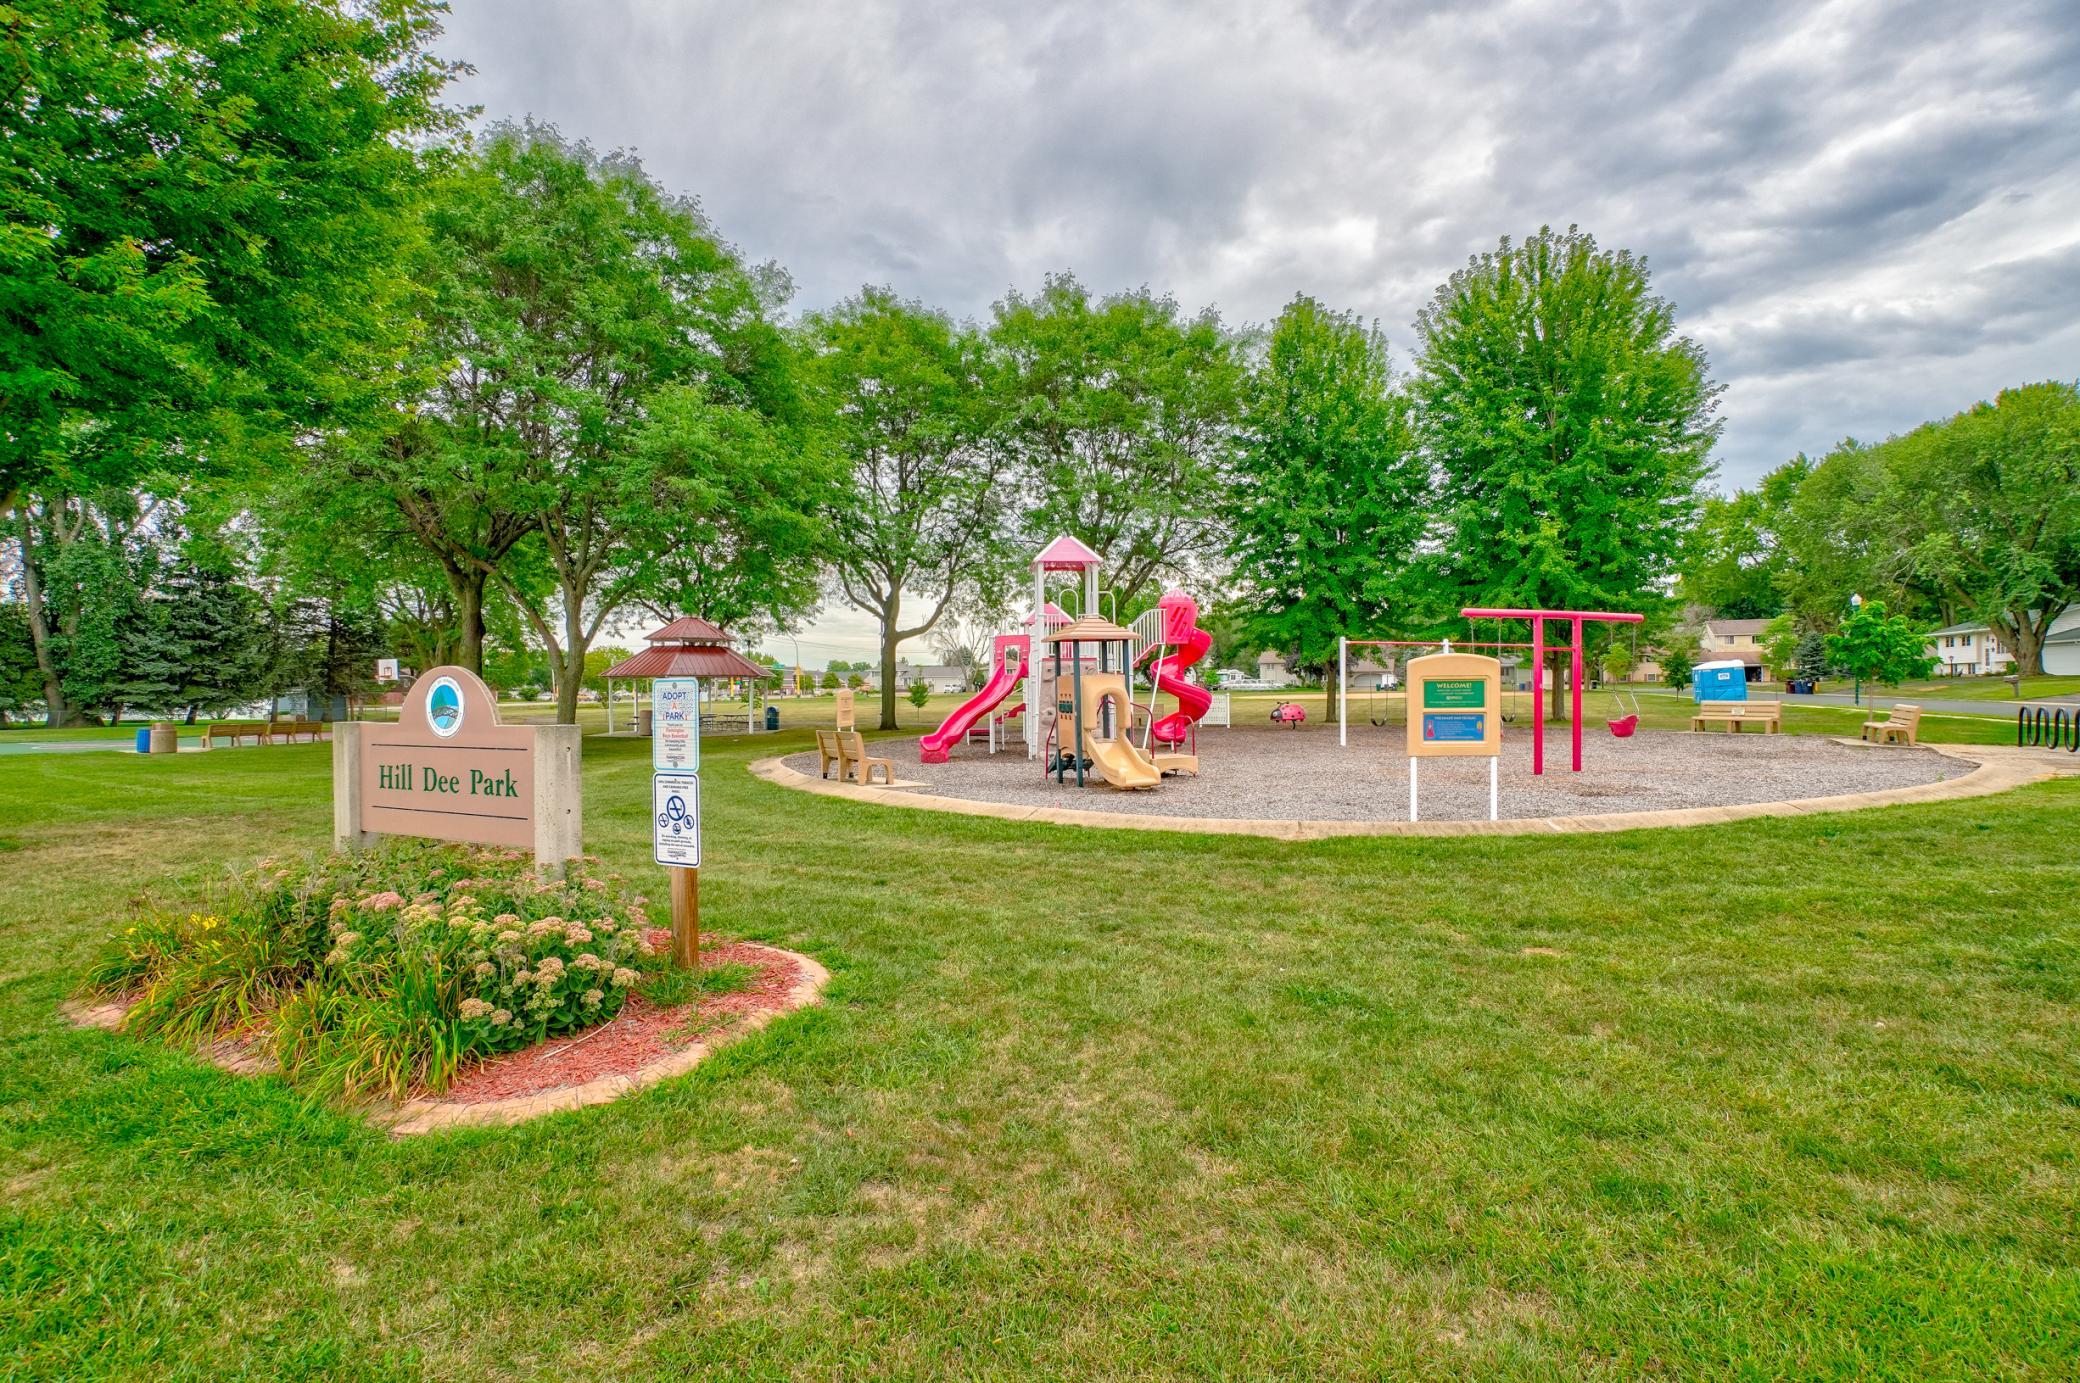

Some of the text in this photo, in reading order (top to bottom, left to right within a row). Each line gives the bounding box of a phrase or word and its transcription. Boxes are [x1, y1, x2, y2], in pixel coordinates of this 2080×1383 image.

[663, 691, 687, 700] ADOPT
[665, 711, 684, 720] PARK
[379, 764, 519, 798] Hill Dee Park
